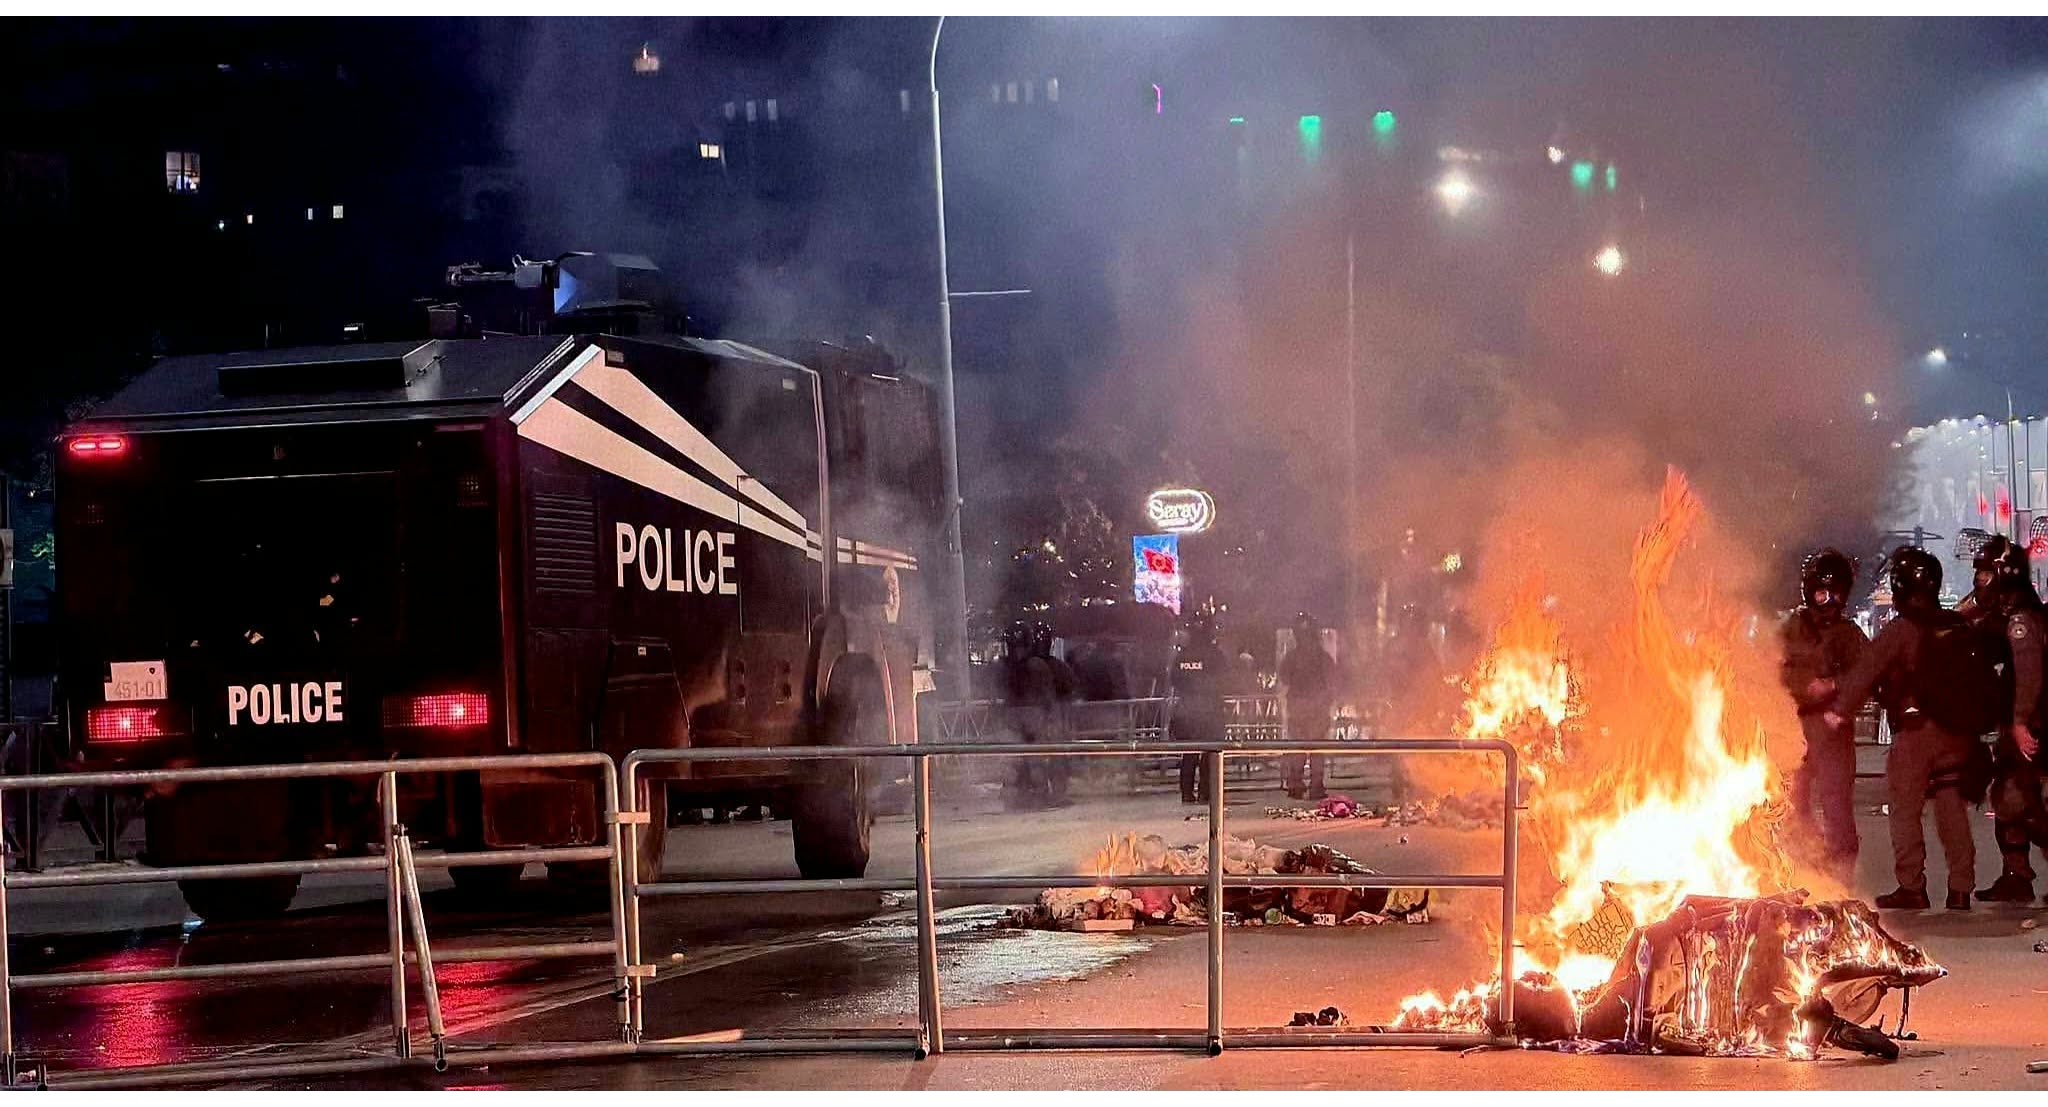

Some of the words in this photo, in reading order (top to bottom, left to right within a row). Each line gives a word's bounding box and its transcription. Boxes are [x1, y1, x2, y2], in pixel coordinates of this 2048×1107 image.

[616, 521, 738, 595] POLICE
[1180, 661, 1203, 671] POLICE
[228, 681, 343, 725] POLICE
